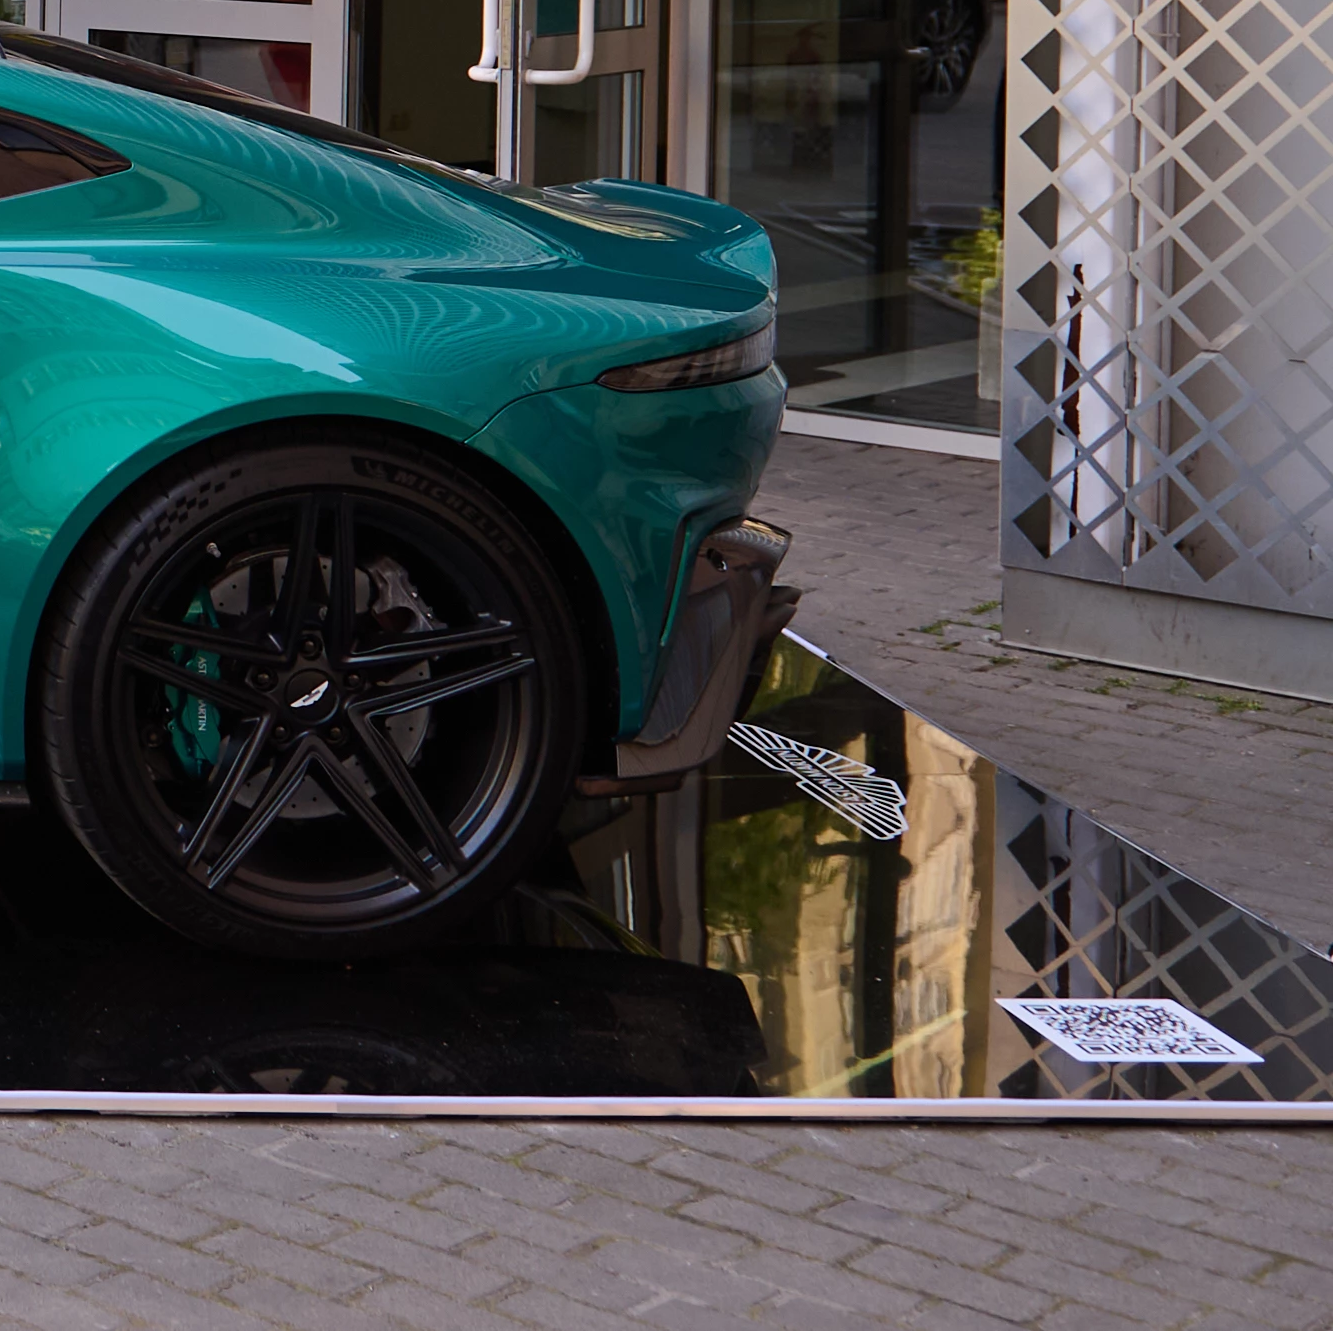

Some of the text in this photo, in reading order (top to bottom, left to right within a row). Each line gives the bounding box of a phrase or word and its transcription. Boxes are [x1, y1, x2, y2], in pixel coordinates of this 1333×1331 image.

[394, 470, 517, 554] MICHELIN
[197, 655, 208, 732] AST ARTIN
